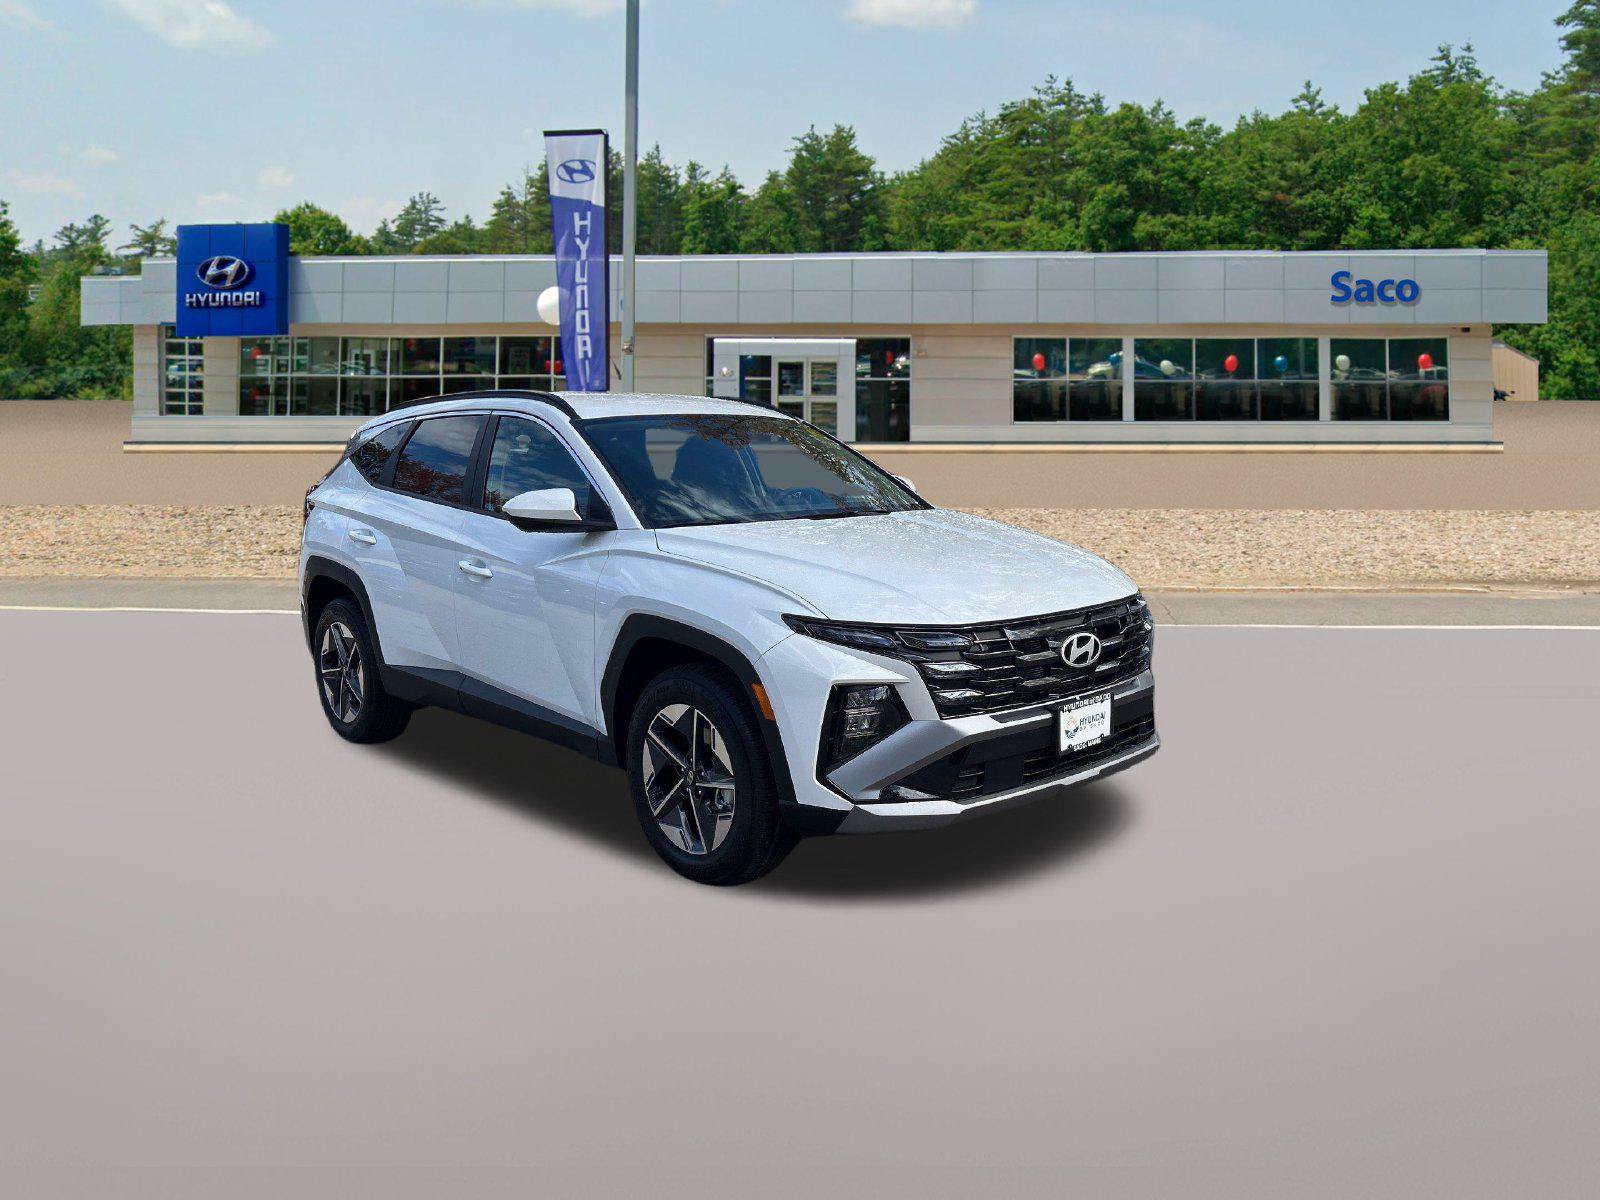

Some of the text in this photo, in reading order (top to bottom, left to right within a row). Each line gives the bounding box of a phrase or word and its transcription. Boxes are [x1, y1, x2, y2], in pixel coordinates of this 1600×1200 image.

[573, 211, 592, 383] HYUNDAI
[1330, 270, 1419, 302] Saco
[185, 291, 260, 307] HYUNDAI
[1079, 711, 1106, 726] HYUNDAI
